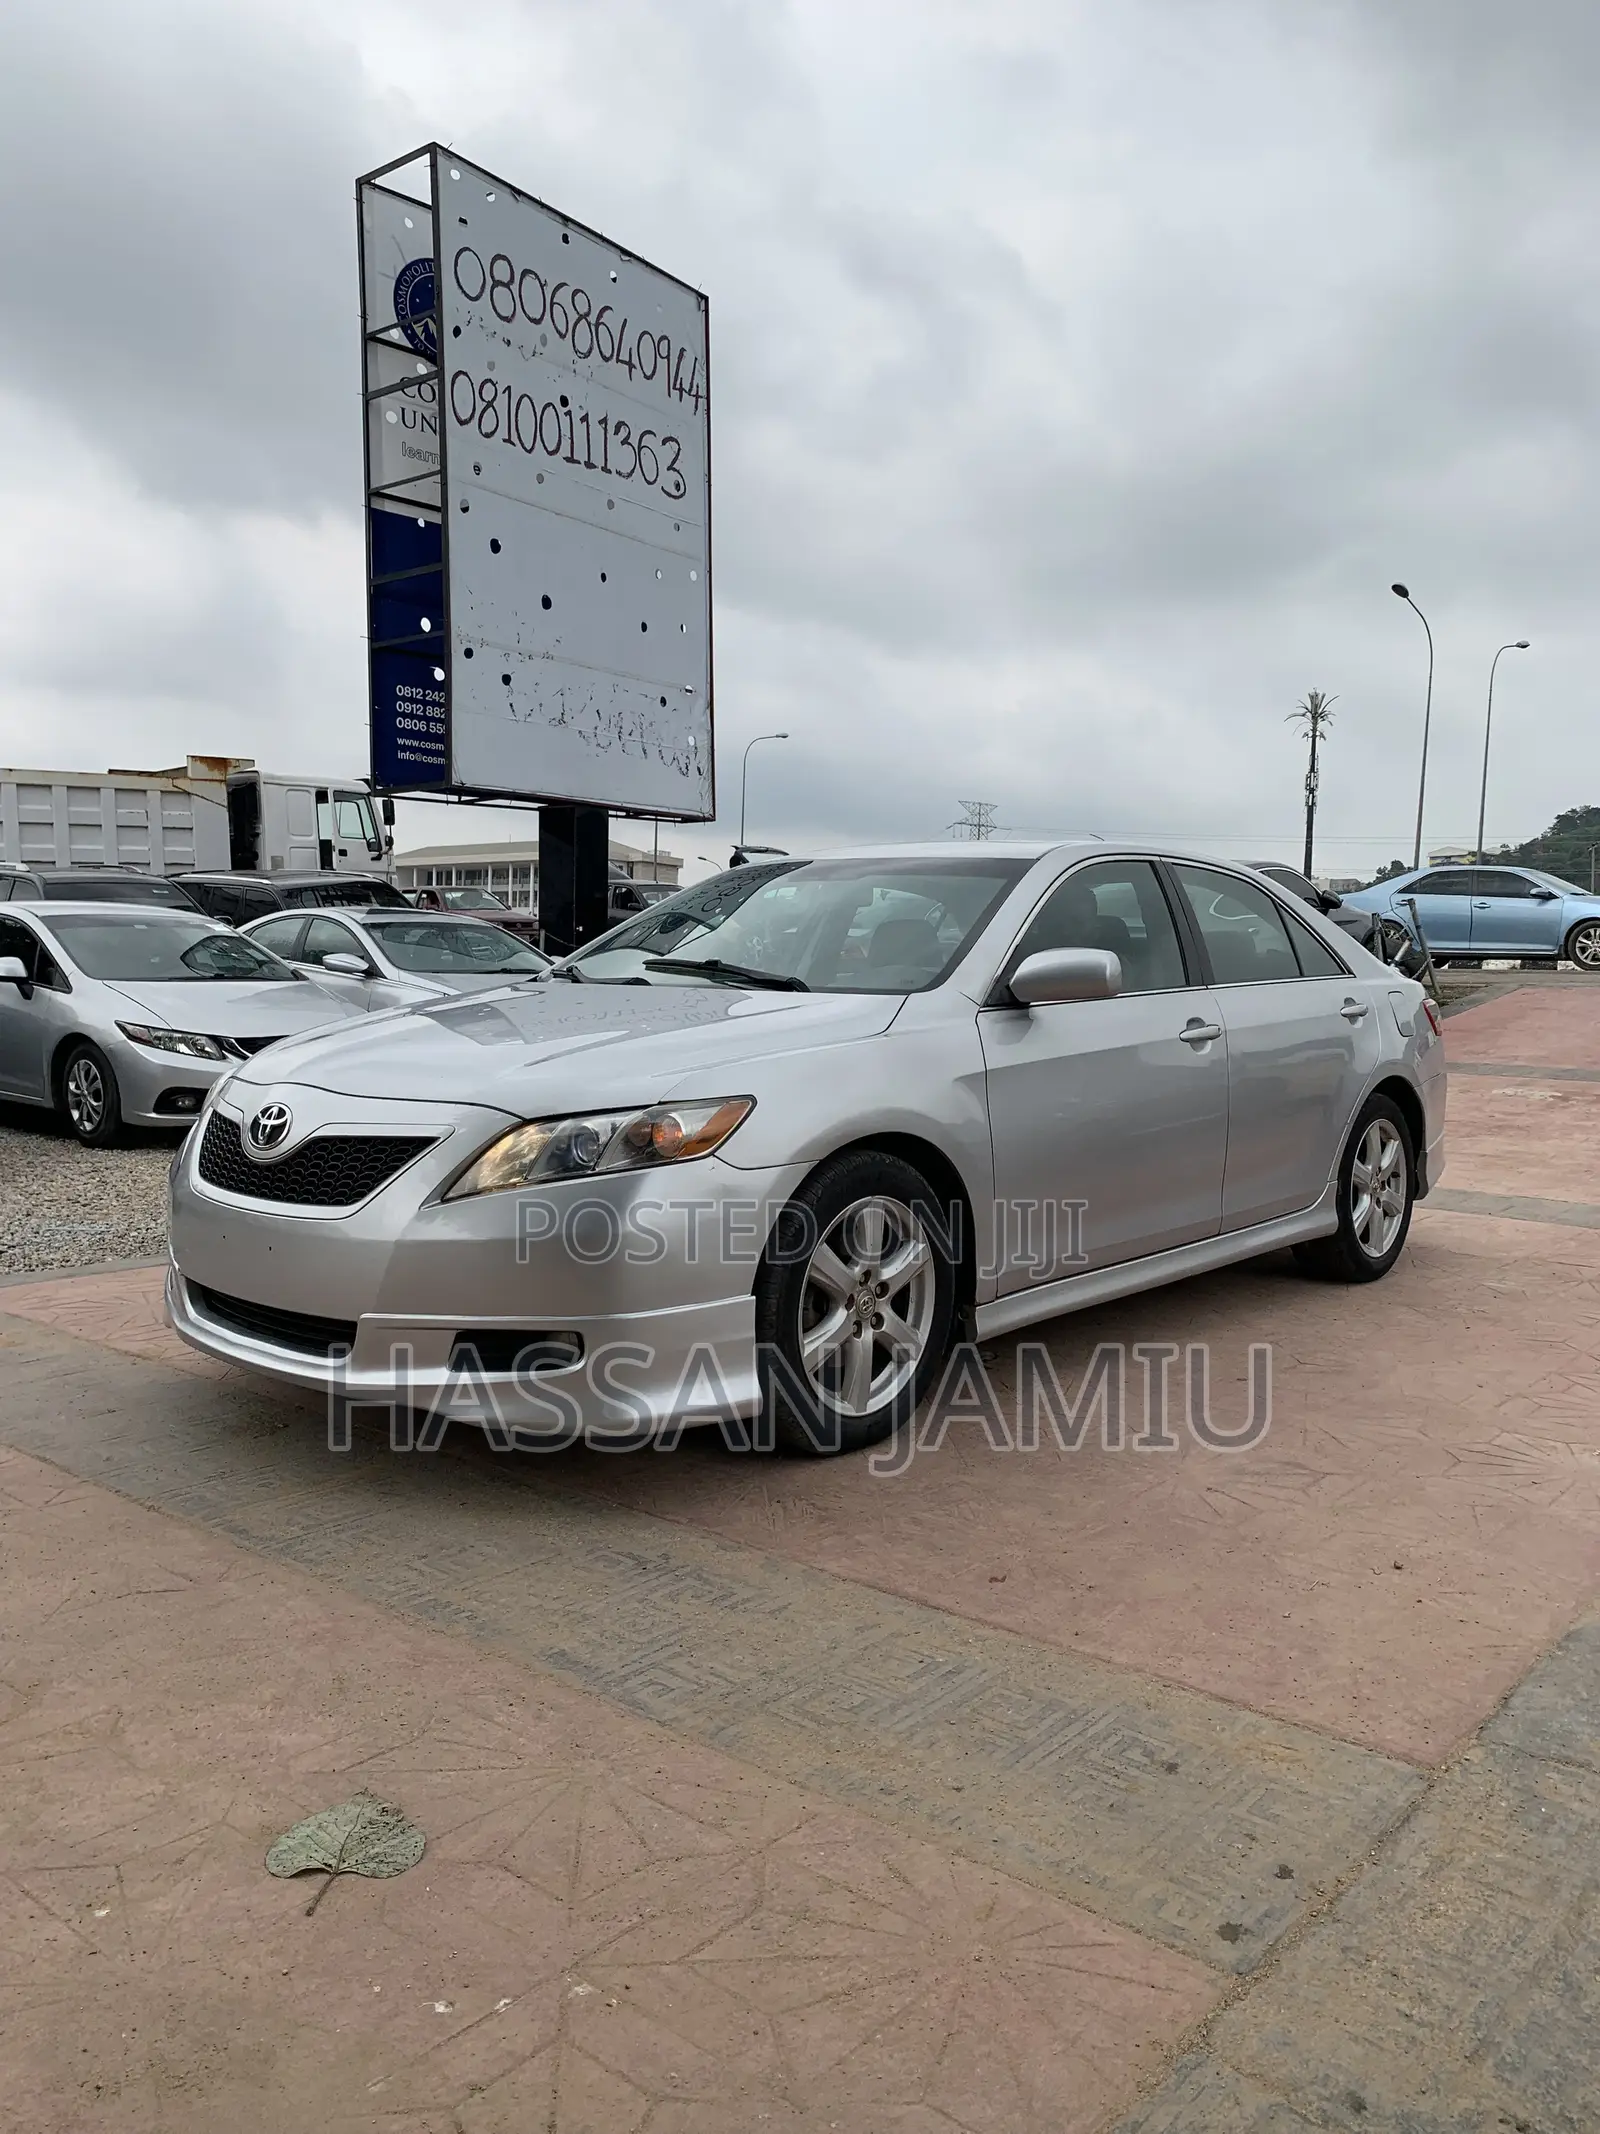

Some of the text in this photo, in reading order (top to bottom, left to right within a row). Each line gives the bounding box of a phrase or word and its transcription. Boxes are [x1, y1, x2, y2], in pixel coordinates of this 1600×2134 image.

[453, 246, 706, 416] 08068640944
[400, 406, 438, 436] UN
[450, 370, 687, 500] 08100111363
[396, 684, 445, 702] 0812 242
[396, 701, 424, 715] 0912
[396, 717, 427, 731] 0806
